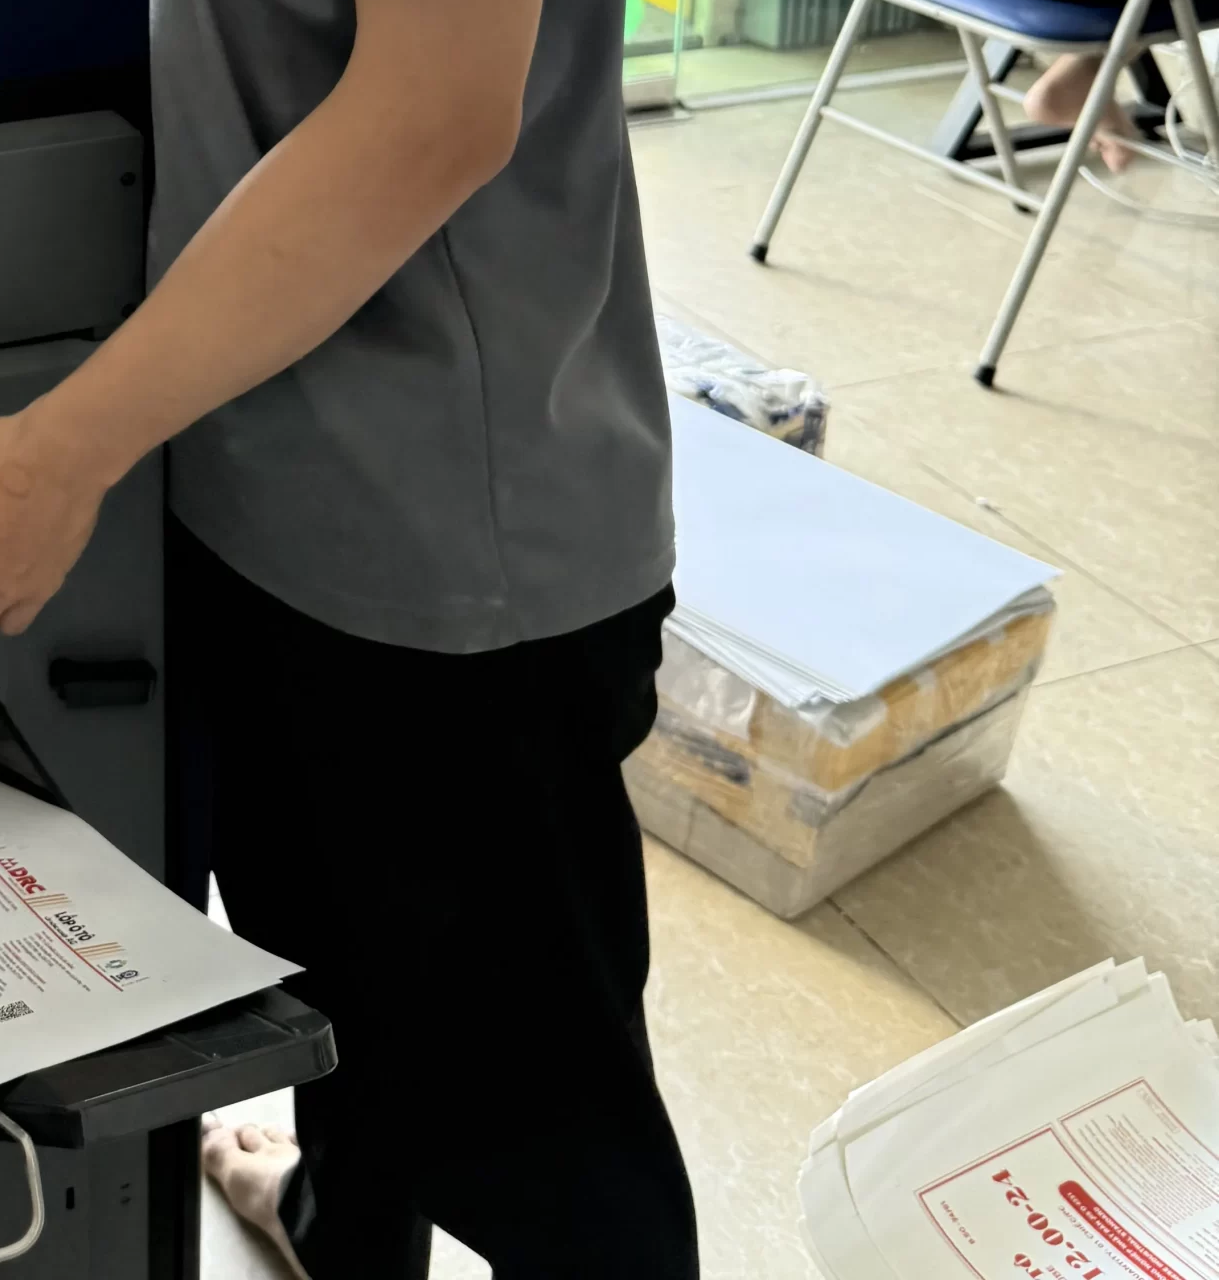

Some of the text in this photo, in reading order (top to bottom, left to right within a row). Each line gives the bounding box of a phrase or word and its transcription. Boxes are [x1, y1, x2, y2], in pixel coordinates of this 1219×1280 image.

[8, 868, 44, 895] DRC
[54, 911, 78, 926] LỐP
[74, 931, 95, 941] TÔ
[991, 1168, 1106, 1280] 12.00-24
